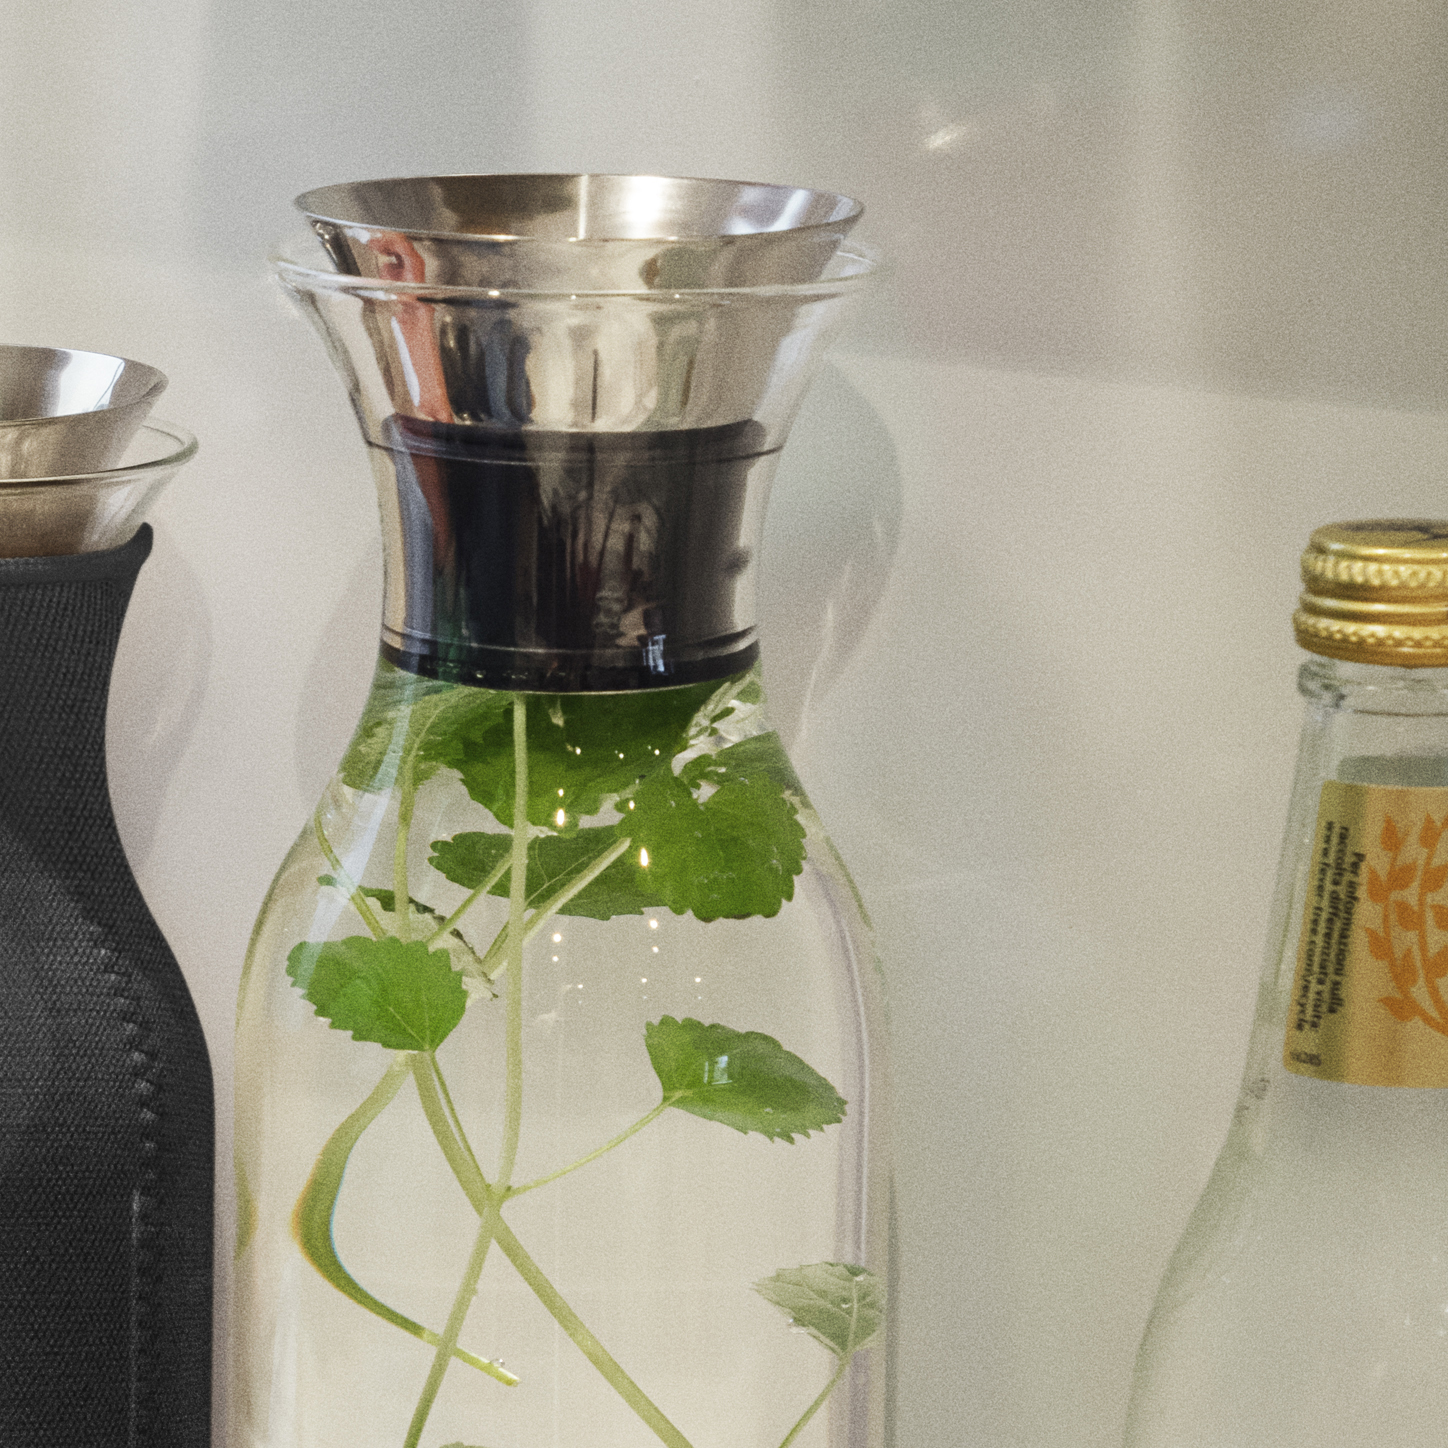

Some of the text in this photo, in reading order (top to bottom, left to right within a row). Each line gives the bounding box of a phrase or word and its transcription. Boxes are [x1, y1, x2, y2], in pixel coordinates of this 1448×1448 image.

[1330, 825, 1350, 887] raccolta
[1316, 889, 1345, 986] differenziata
[1327, 851, 1366, 1015] Per informazioni sulla
